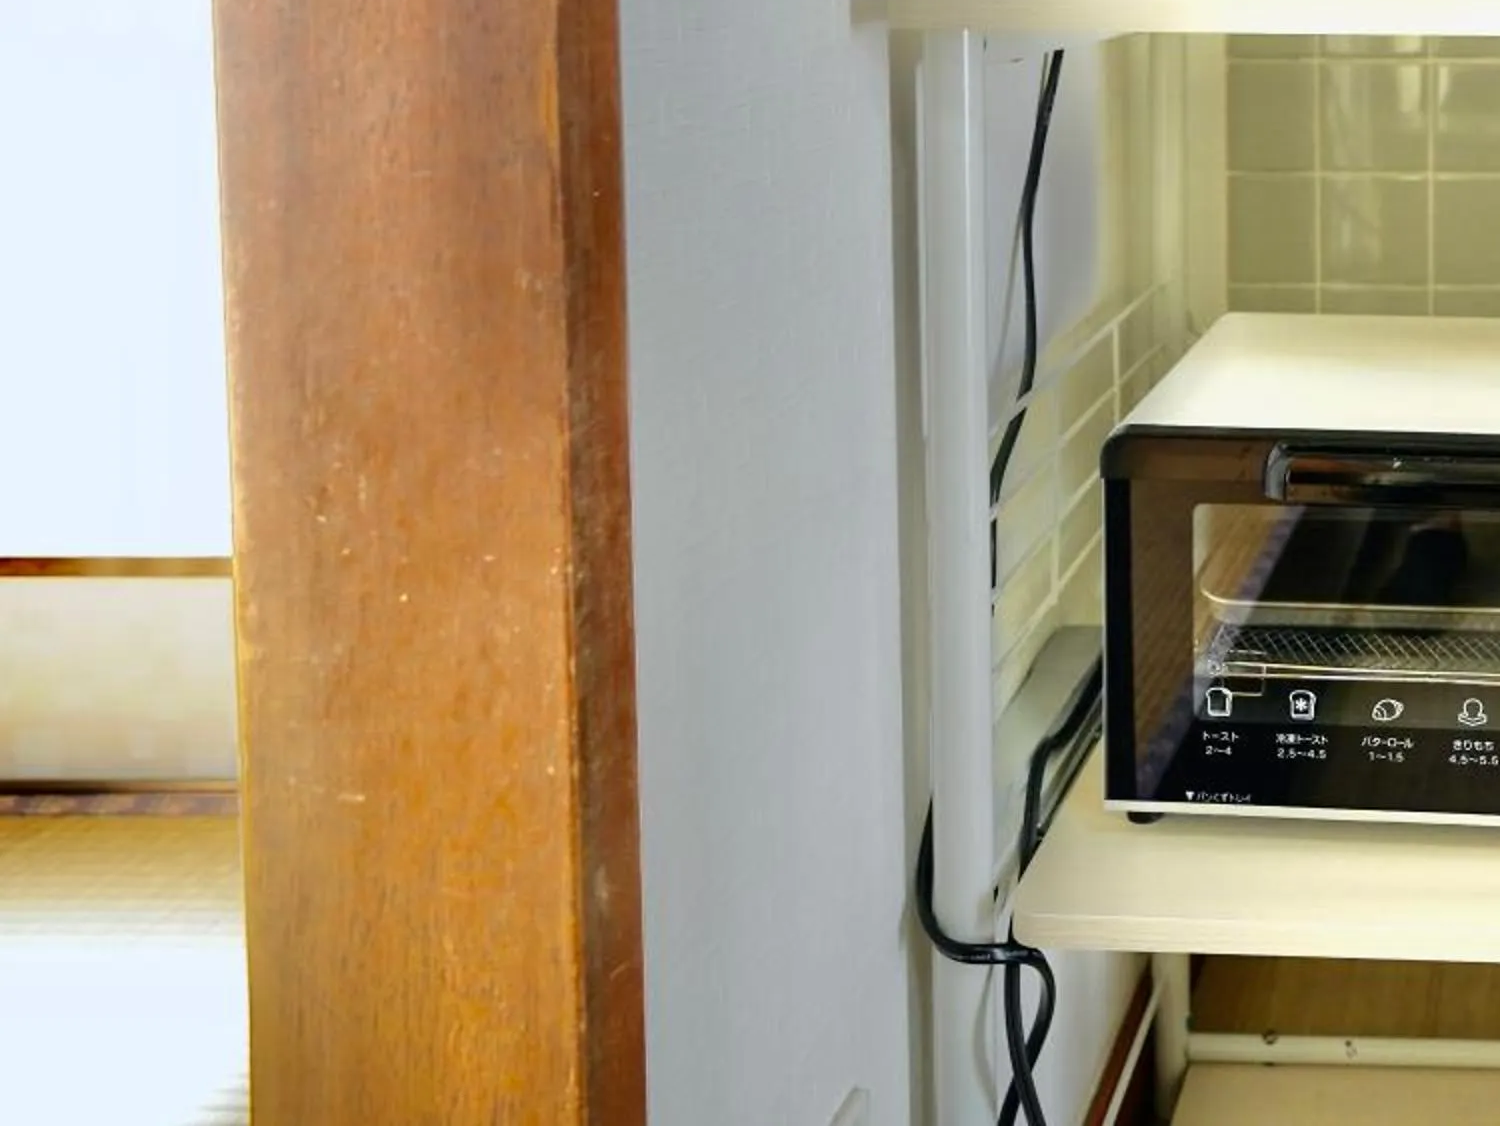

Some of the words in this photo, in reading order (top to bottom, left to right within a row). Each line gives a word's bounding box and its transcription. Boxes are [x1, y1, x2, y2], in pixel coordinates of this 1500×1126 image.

[1202, 731, 1240, 742] トースト
[1275, 733, 1329, 745] 冷凍トースト
[1452, 739, 1495, 751] きりもち
